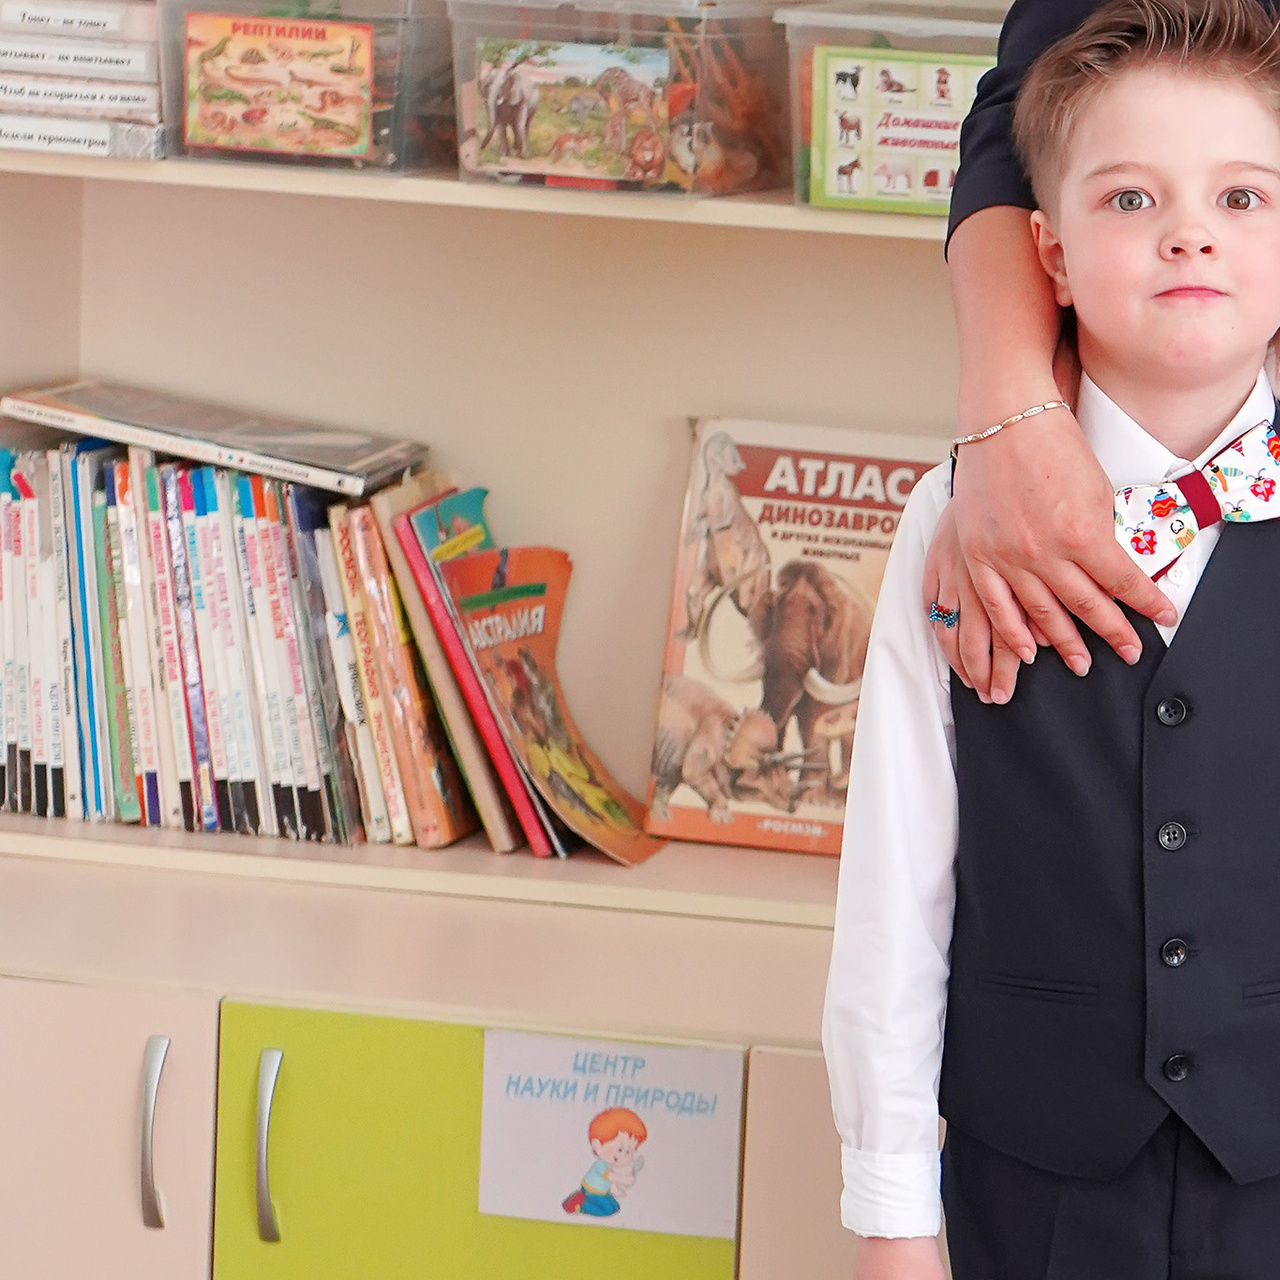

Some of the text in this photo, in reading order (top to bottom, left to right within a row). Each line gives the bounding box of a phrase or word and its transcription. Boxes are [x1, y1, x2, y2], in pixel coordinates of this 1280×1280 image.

[231, 21, 327, 41] РЕПТИЛИИ
[764, 454, 917, 505] АТЛАС
[758, 502, 900, 534] ДИНОЗАВРО
[573, 1051, 647, 1078] ЦЕНТР
[505, 1074, 718, 1116] НАУКИ И ПРИРОДЫ
